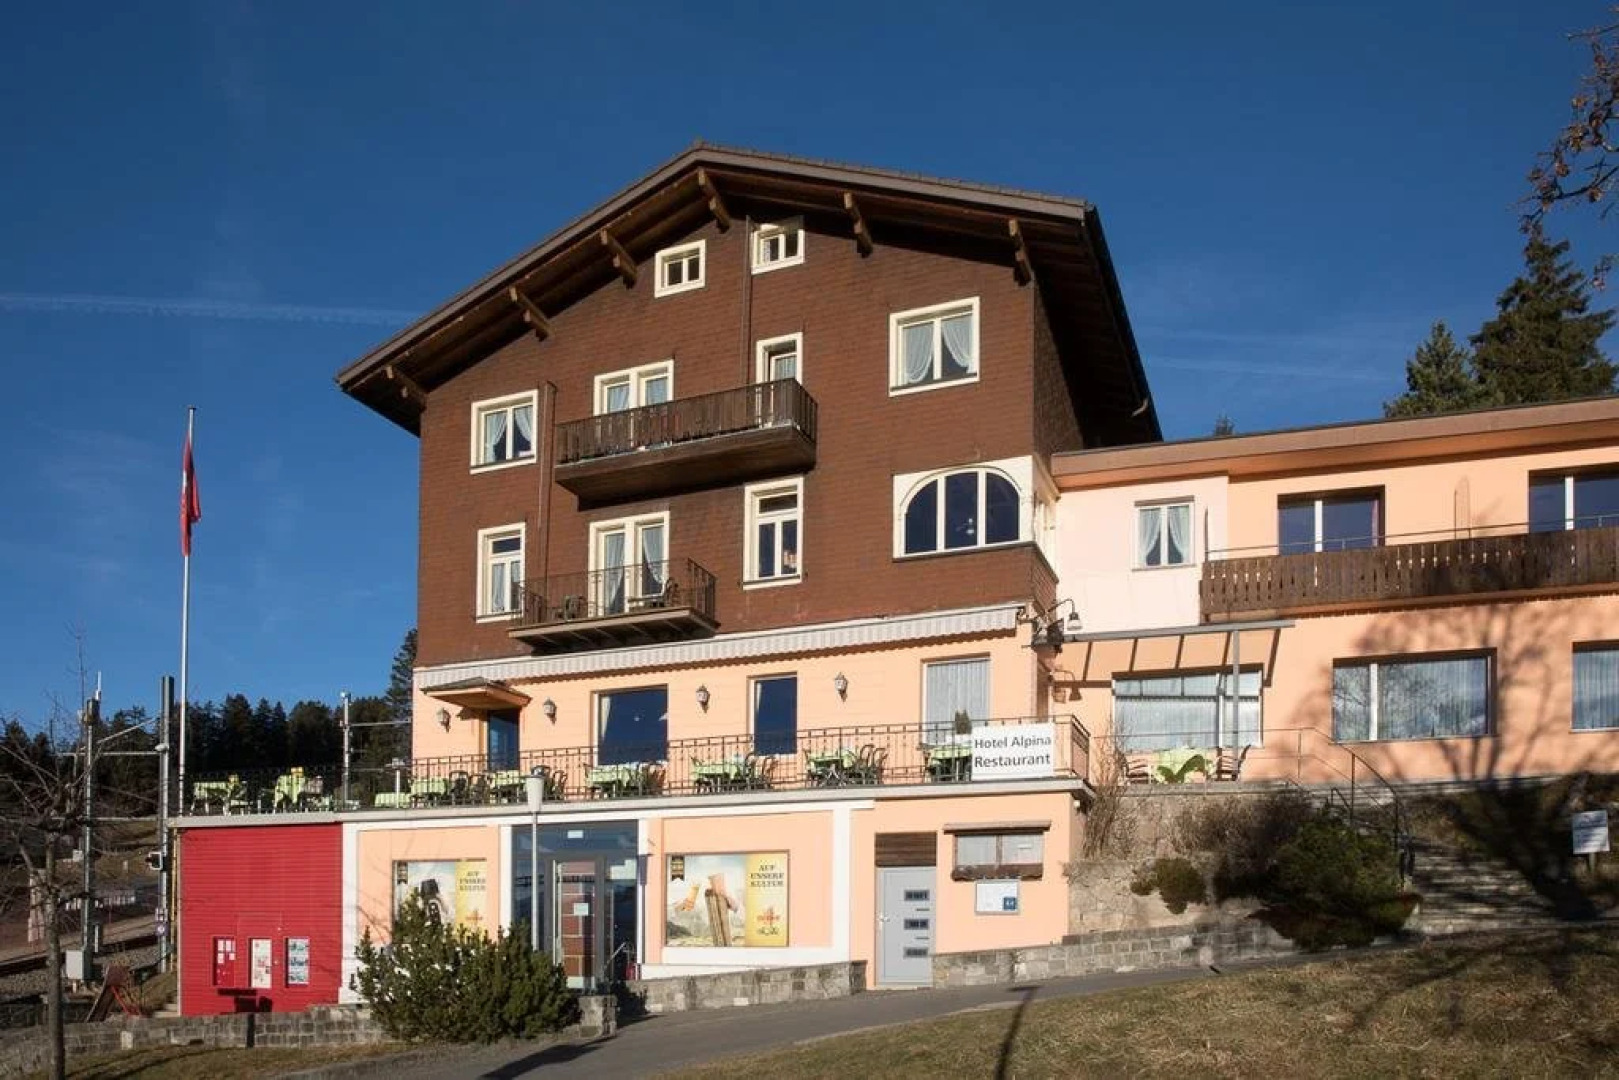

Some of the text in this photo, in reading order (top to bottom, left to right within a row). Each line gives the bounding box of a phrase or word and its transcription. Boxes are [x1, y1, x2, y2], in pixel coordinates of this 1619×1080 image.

[975, 735, 1052, 749] Hotel Alpina
[974, 754, 1051, 768] Restaurant
